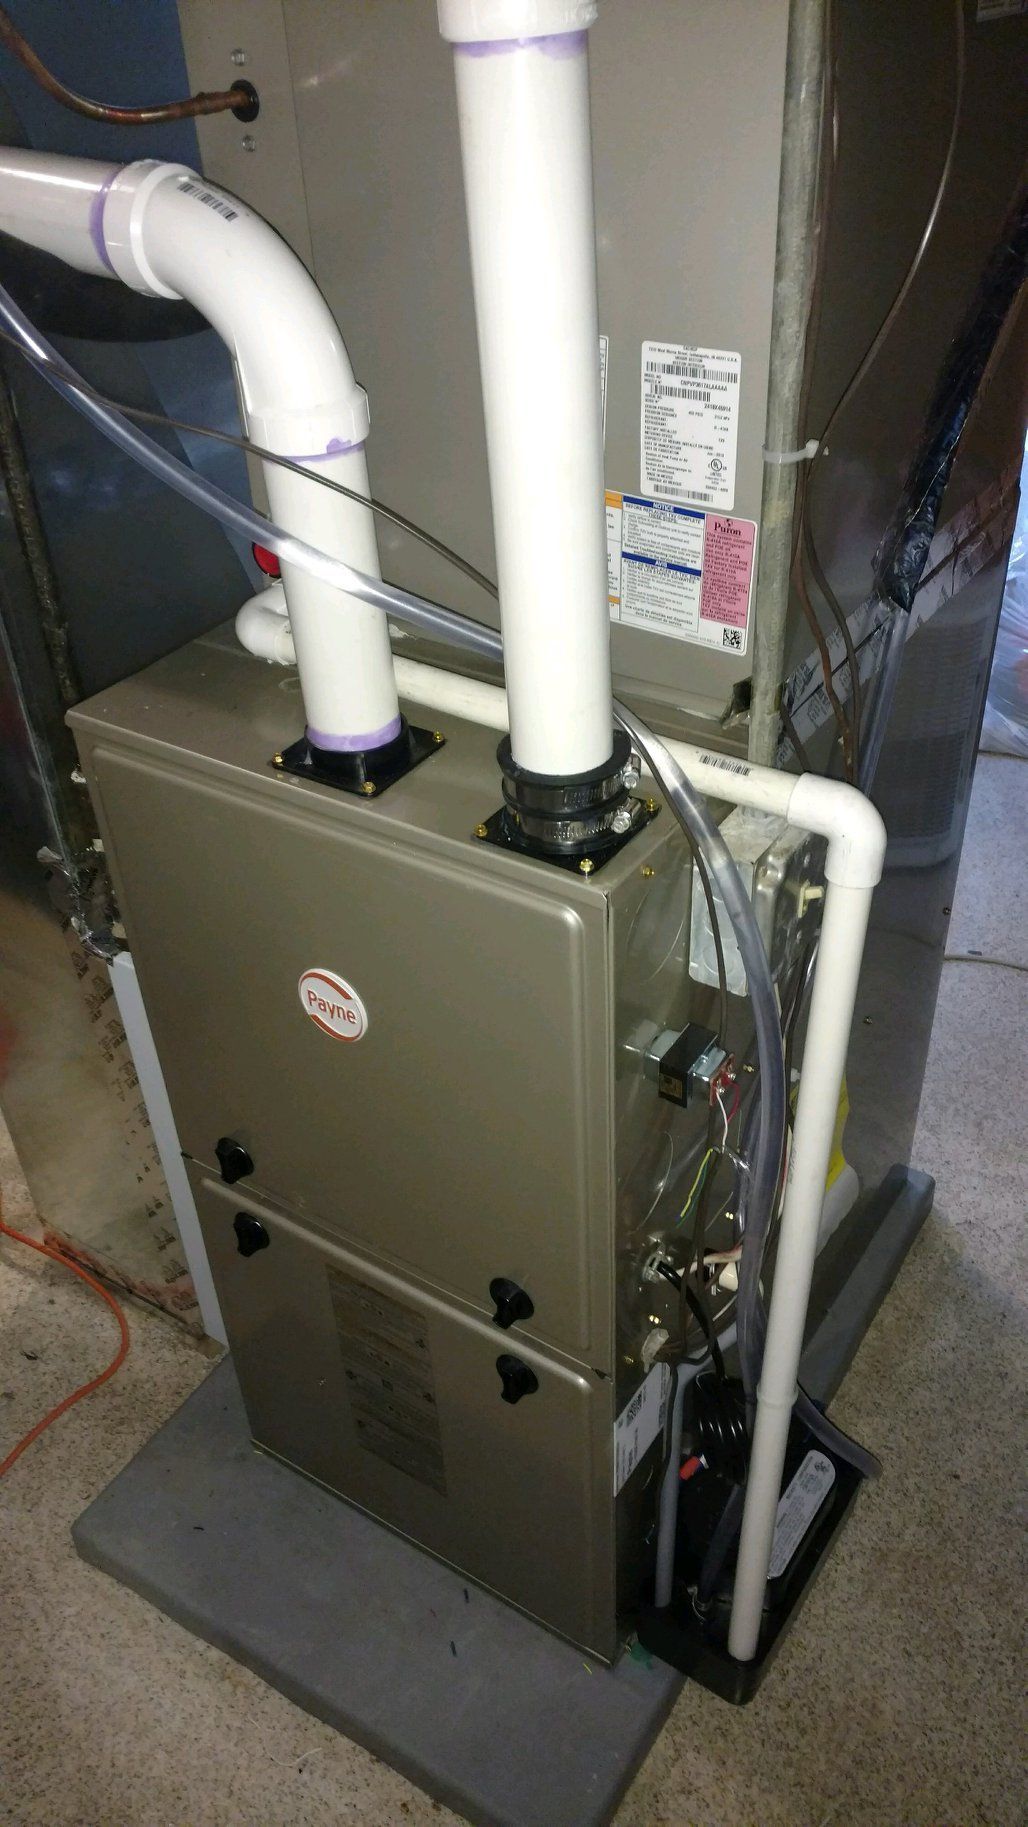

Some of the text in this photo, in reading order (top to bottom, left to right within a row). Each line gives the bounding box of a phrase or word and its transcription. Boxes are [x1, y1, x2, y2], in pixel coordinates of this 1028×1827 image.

[652, 503, 673, 512] NOTICE
[713, 522, 741, 536] Puron
[307, 989, 356, 1024] Payne
